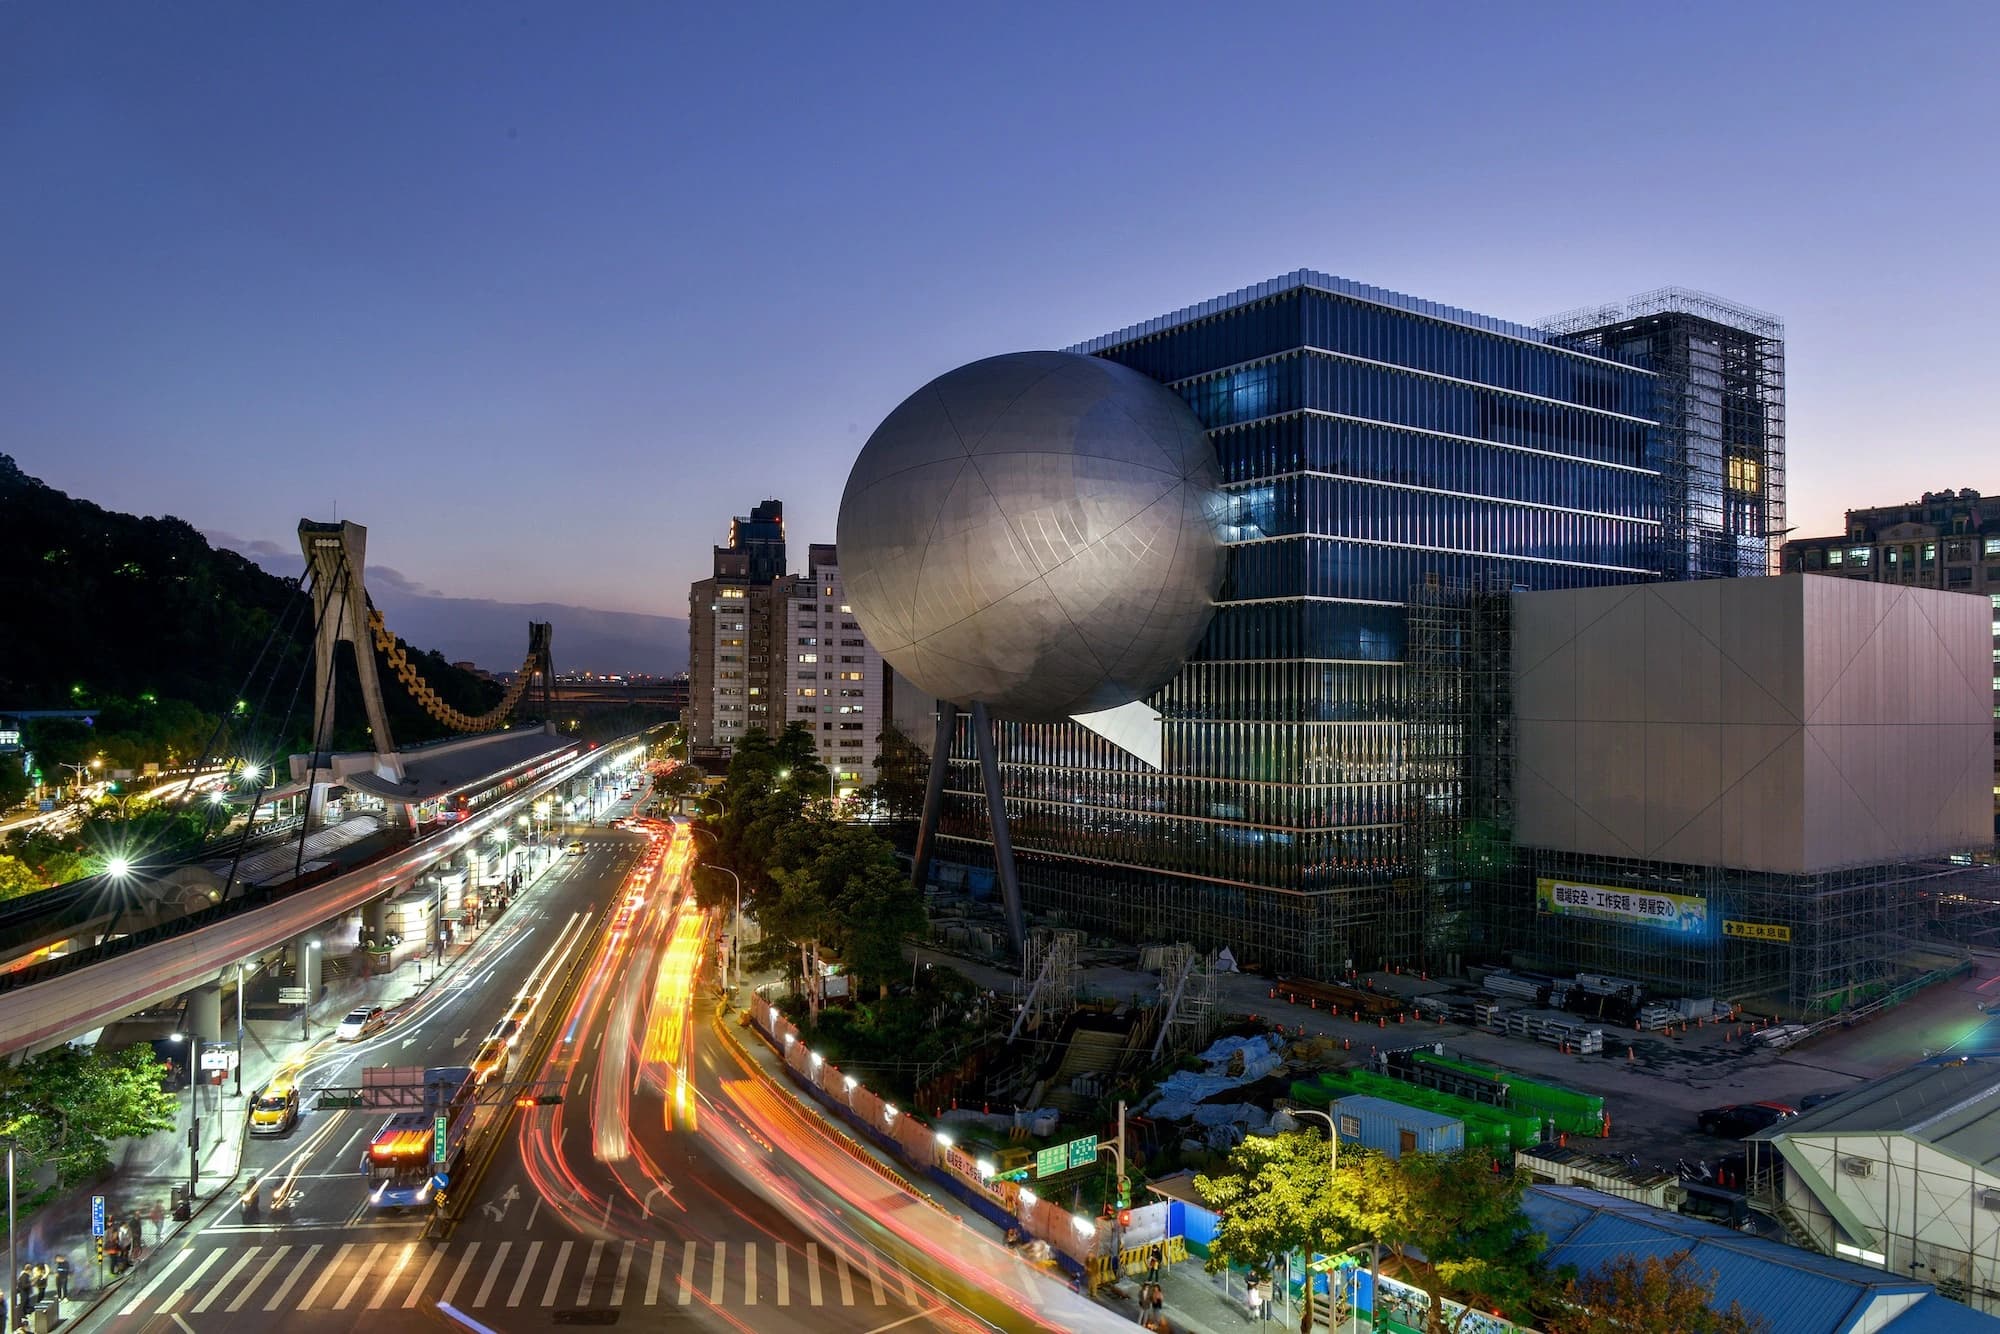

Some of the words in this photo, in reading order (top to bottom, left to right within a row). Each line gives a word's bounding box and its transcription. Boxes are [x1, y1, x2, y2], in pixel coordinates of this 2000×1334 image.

[1736, 924, 1787, 938] 勞工休息區
